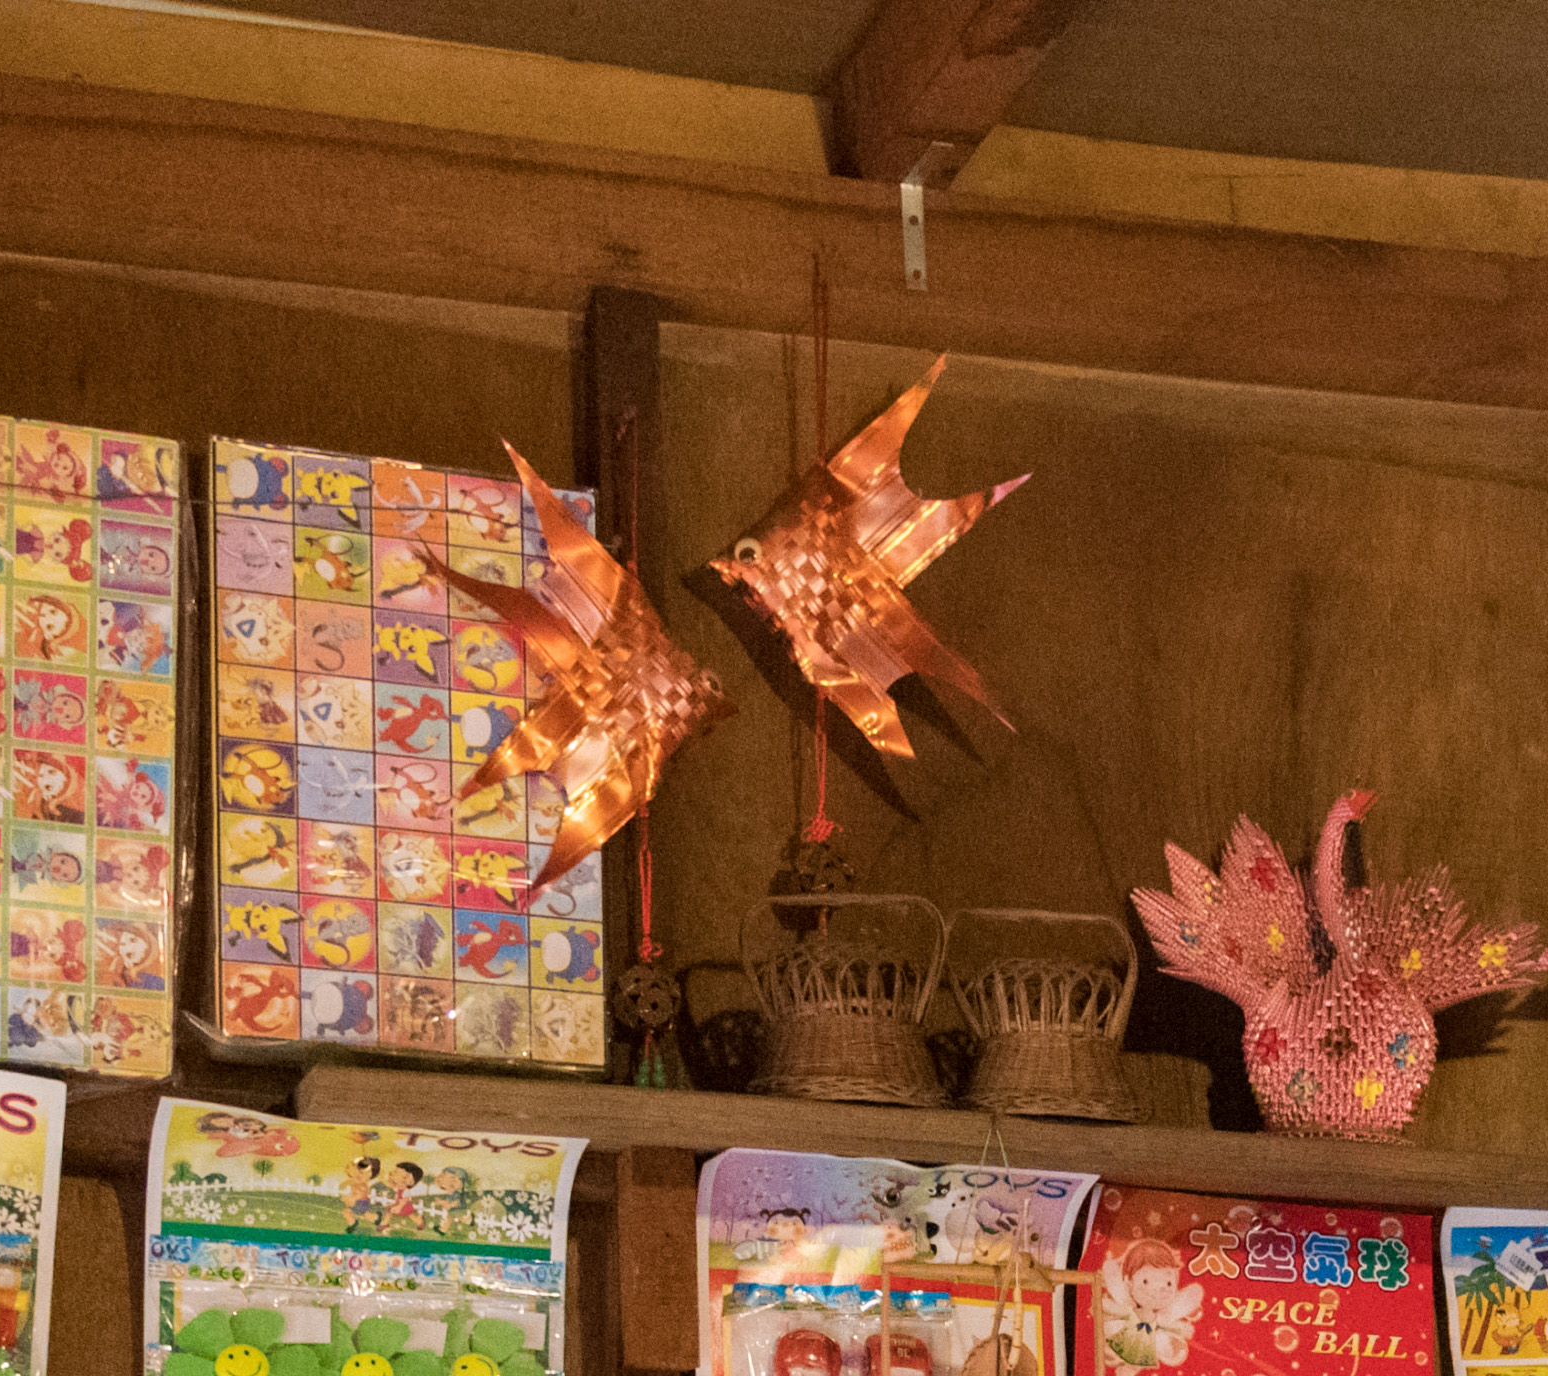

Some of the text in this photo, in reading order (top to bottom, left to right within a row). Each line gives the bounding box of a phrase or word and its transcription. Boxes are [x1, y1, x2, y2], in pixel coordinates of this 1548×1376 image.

[397, 1131, 561, 1158] TOYS
[1188, 1222, 1409, 1292] 太空氣球
[1219, 1296, 1338, 1327] SPACE
[1312, 1331, 1407, 1359] BALL
